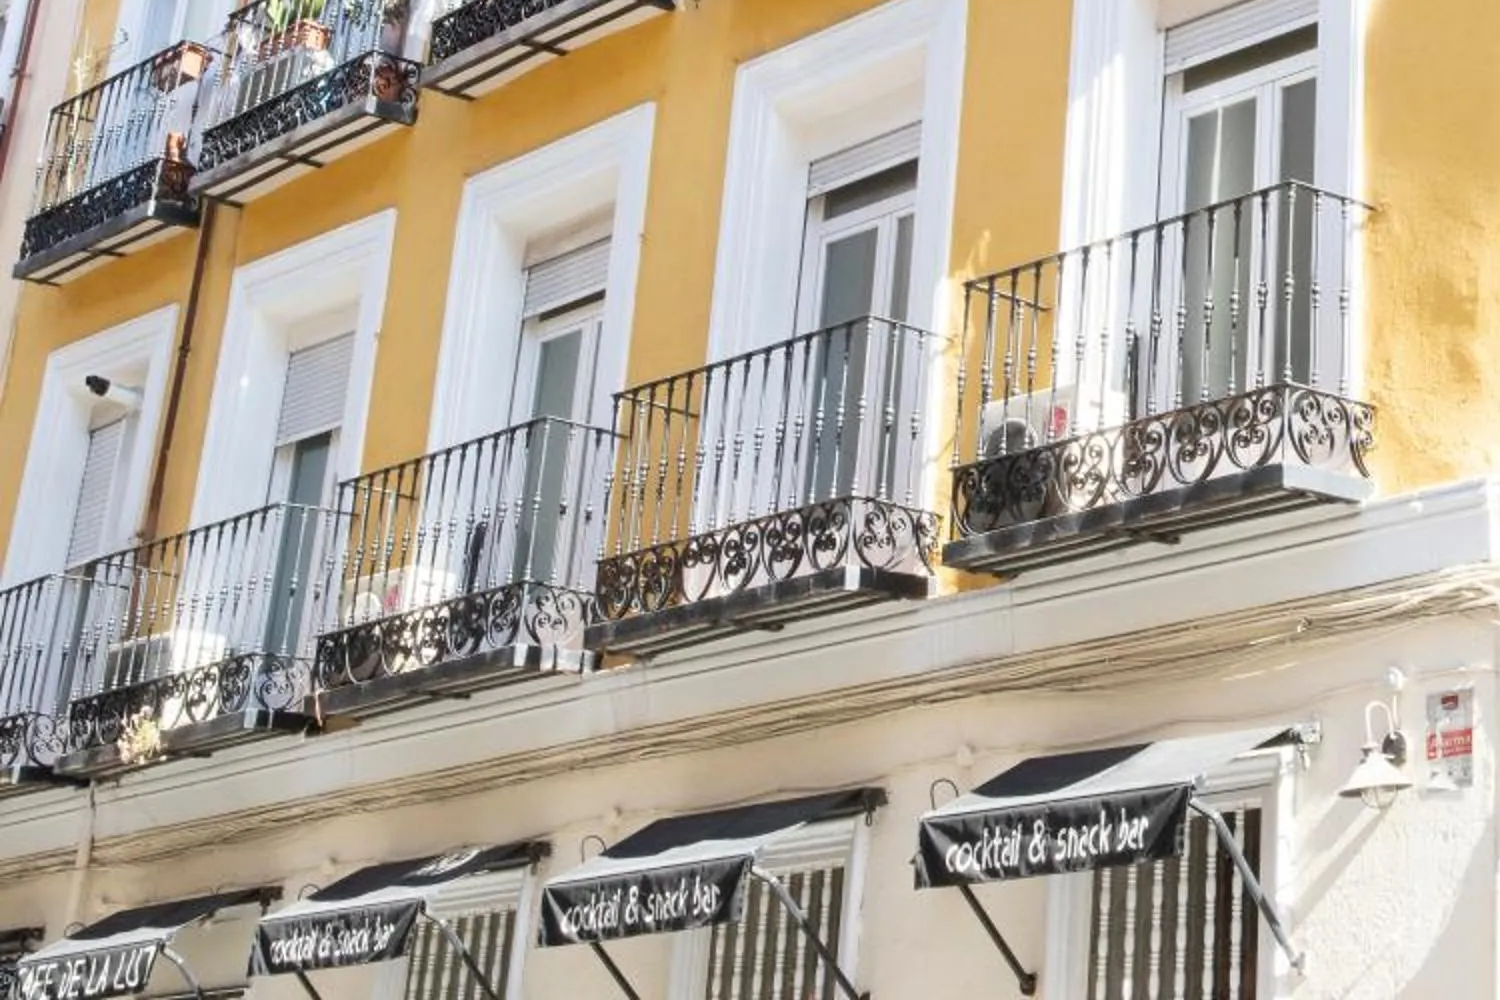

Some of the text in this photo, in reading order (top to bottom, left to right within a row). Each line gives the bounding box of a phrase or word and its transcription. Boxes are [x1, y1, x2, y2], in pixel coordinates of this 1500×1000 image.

[945, 807, 1149, 873] cocktail & snack bar
[560, 875, 721, 934] cocktail & snack bar
[270, 928, 318, 964] cocktail
[334, 918, 371, 956] snack
[57, 958, 87, 1000] DE
[84, 954, 111, 996] LA
